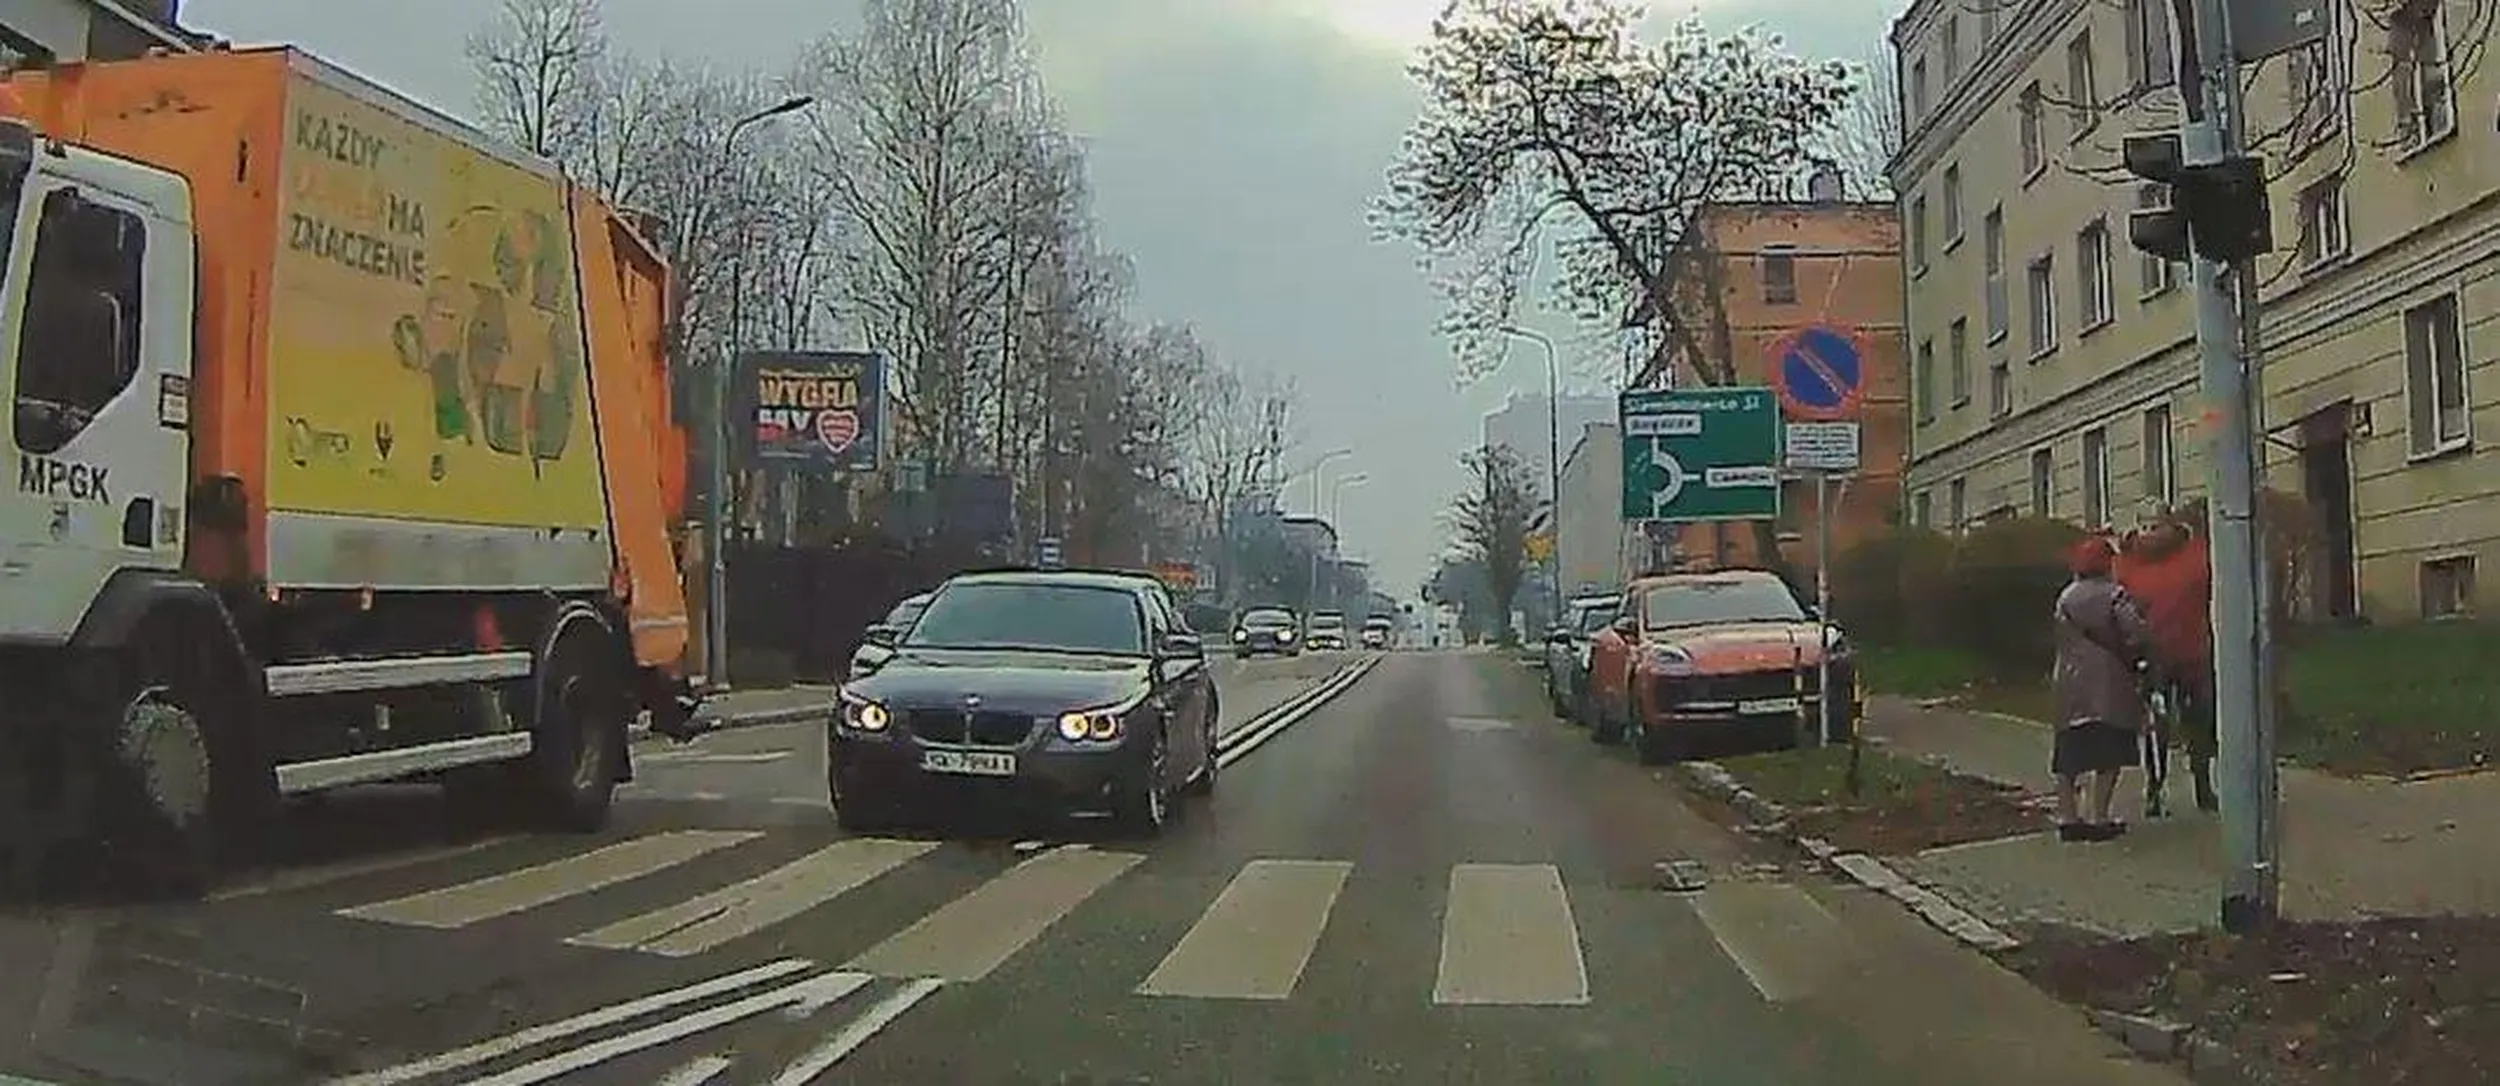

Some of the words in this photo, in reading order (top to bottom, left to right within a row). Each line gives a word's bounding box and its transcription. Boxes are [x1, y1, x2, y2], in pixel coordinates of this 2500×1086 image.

[387, 192, 424, 239] MA
[288, 212, 425, 286] ZNACZENIE
[19, 454, 110, 505] MPGK
